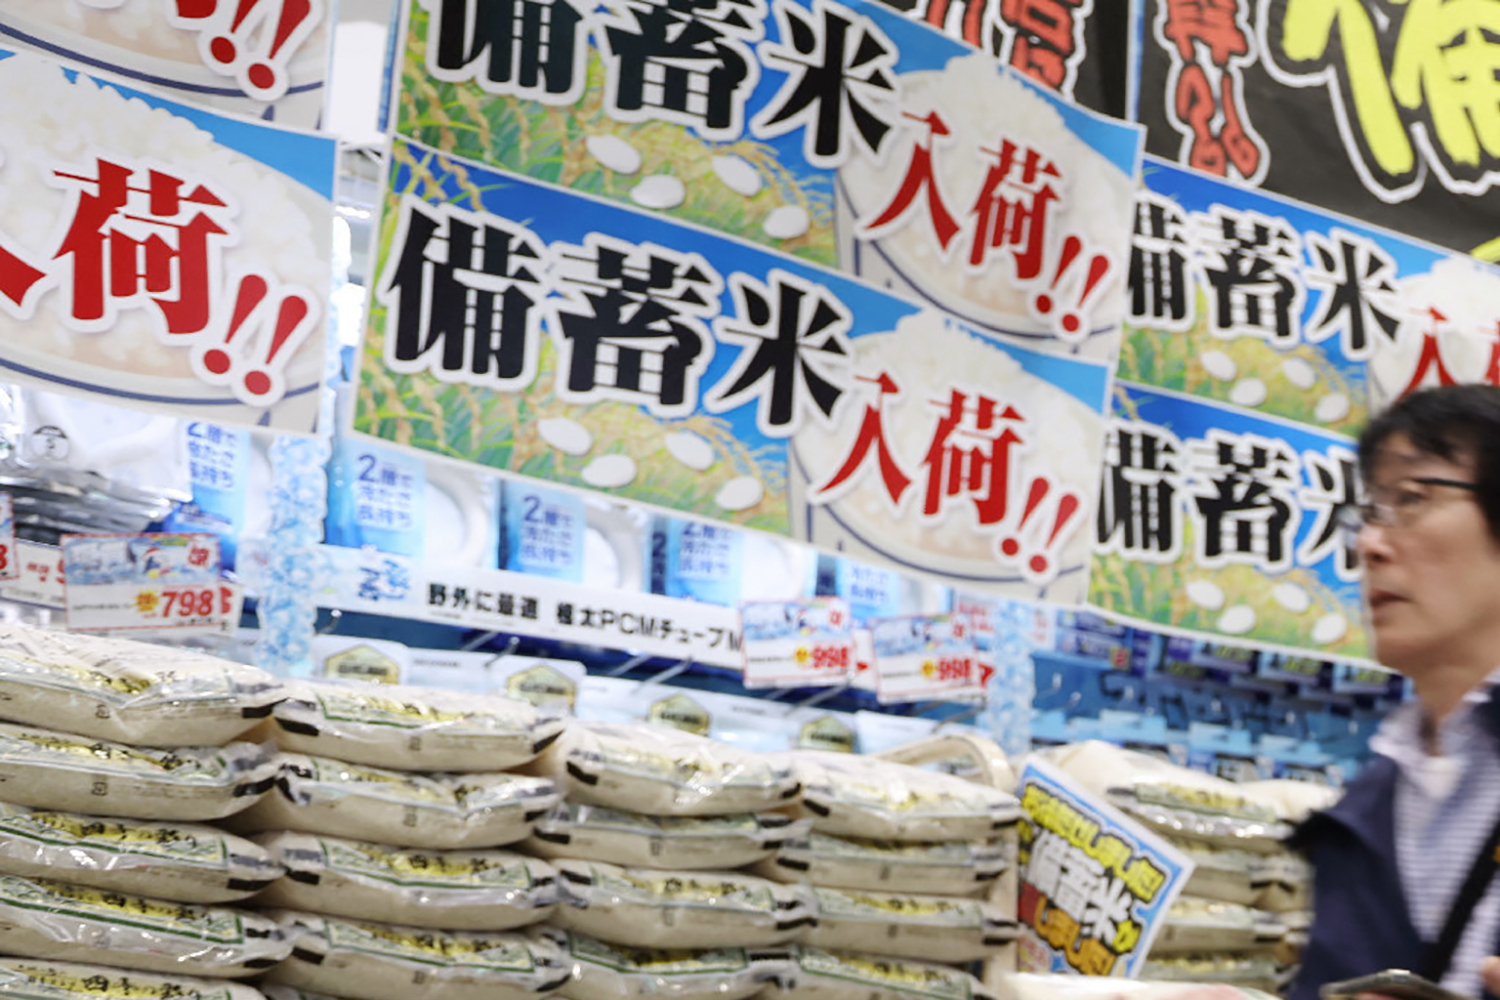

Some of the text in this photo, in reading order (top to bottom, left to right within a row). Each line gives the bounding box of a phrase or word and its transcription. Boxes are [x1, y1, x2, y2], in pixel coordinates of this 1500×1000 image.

[386, 203, 850, 426] 備蓄米
[161, 590, 215, 618] 798
